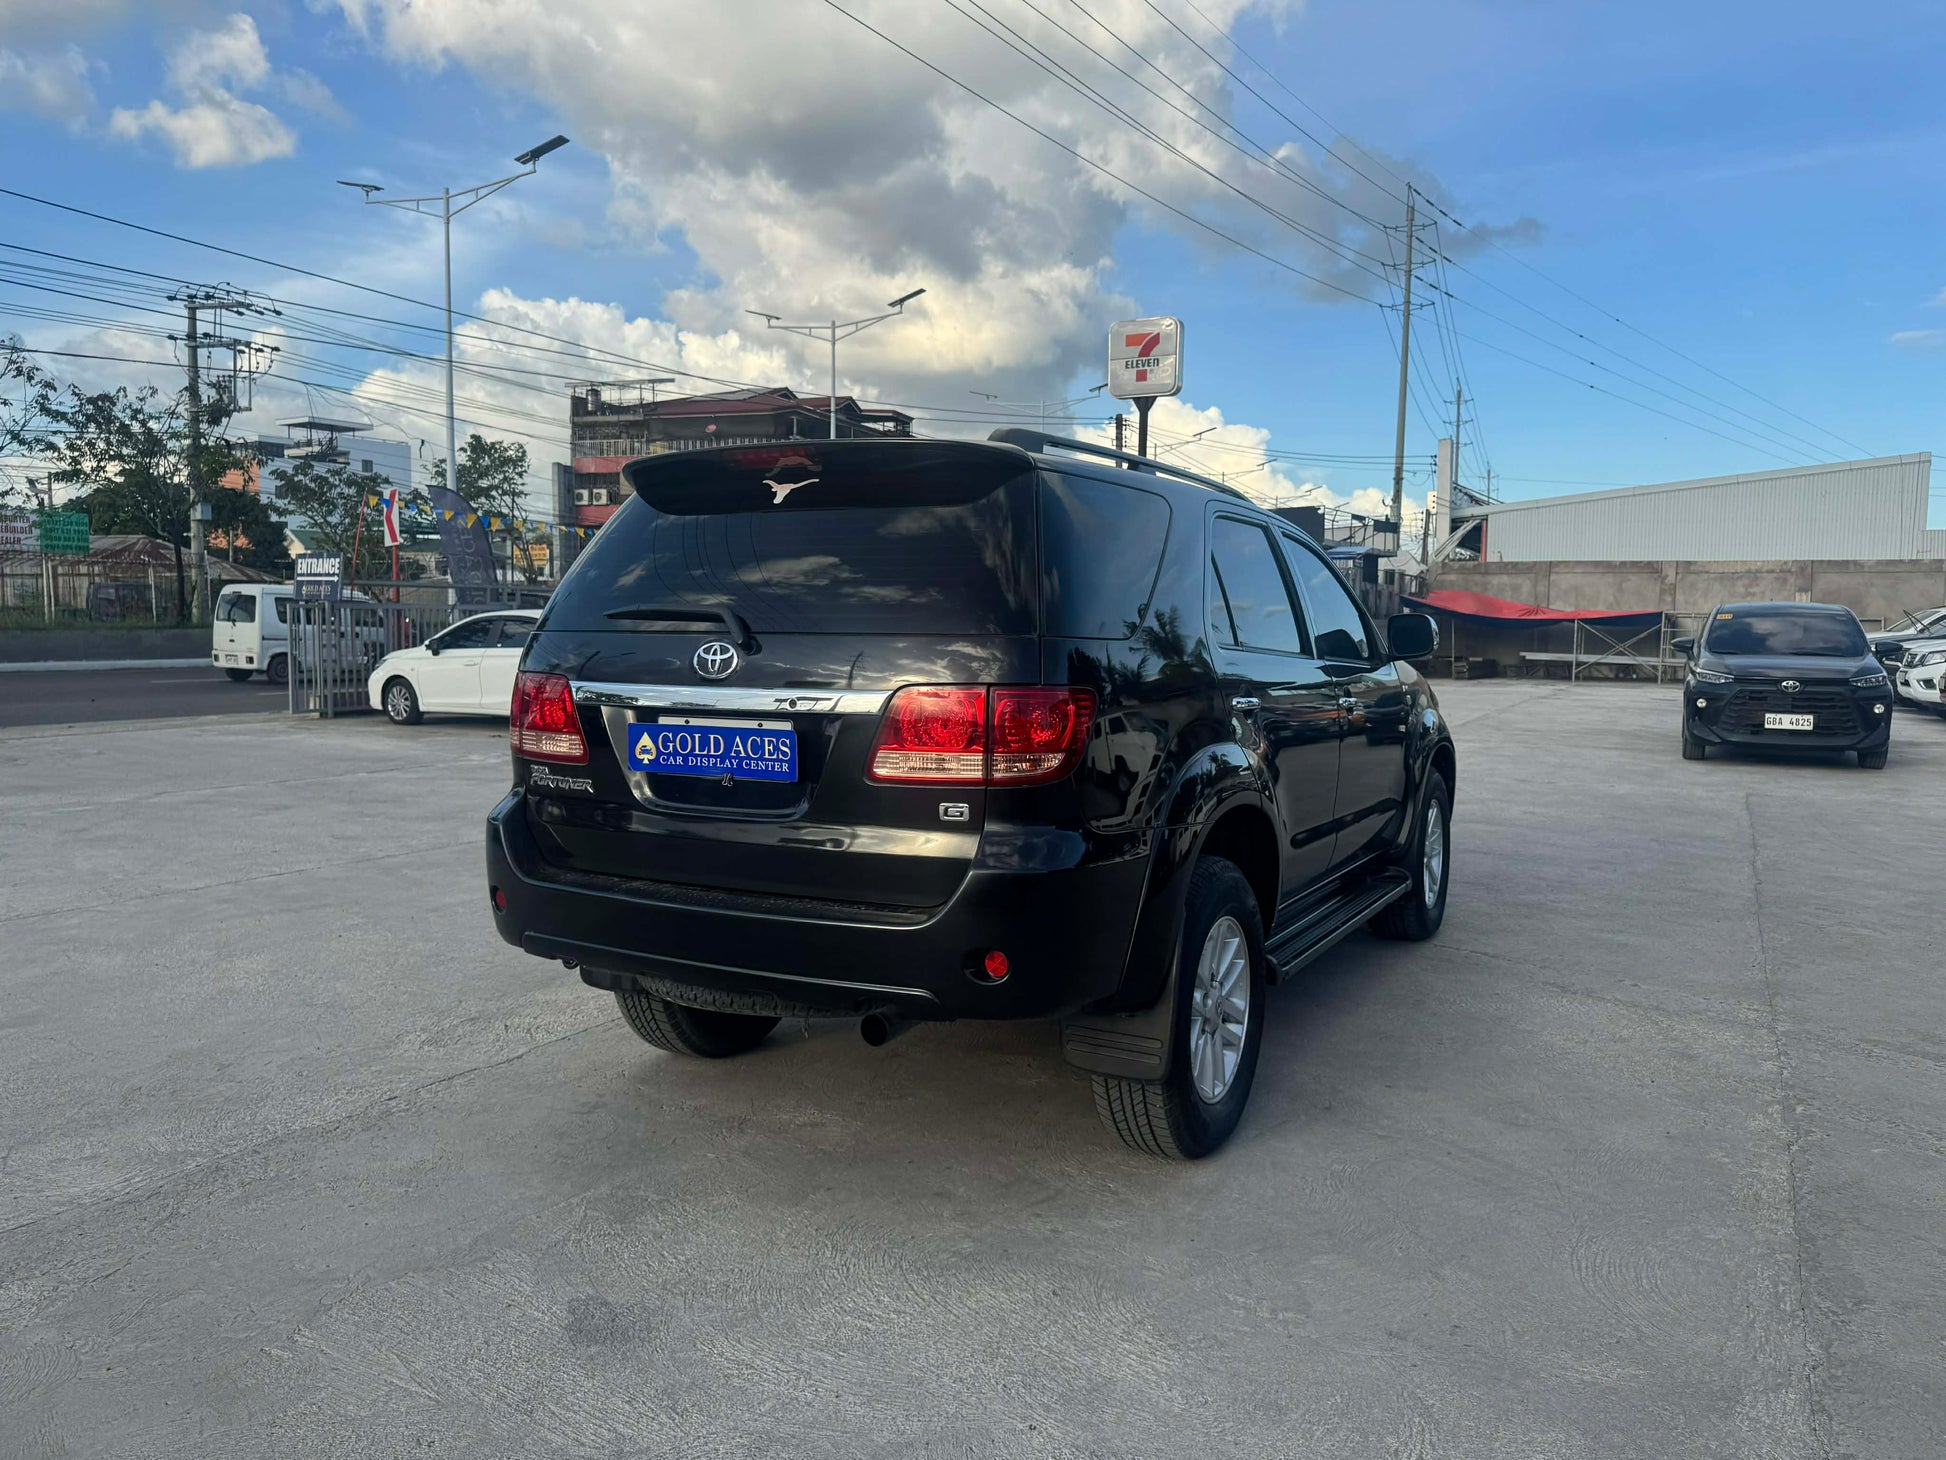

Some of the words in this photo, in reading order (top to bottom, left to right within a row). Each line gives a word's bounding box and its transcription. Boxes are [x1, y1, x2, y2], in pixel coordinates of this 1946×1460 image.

[1125, 332, 1161, 382] 7
[297, 558, 340, 574] ENTRANCE
[1766, 717, 1783, 726] GBA
[1789, 717, 1812, 727] 4825
[658, 731, 725, 756] GOLD
[730, 735, 791, 761] ACES
[659, 755, 684, 766] CAR
[688, 757, 740, 769] DISPLAY
[742, 760, 790, 773] CENTER
[530, 772, 594, 793] FORTUNER
[939, 802, 970, 822] G
